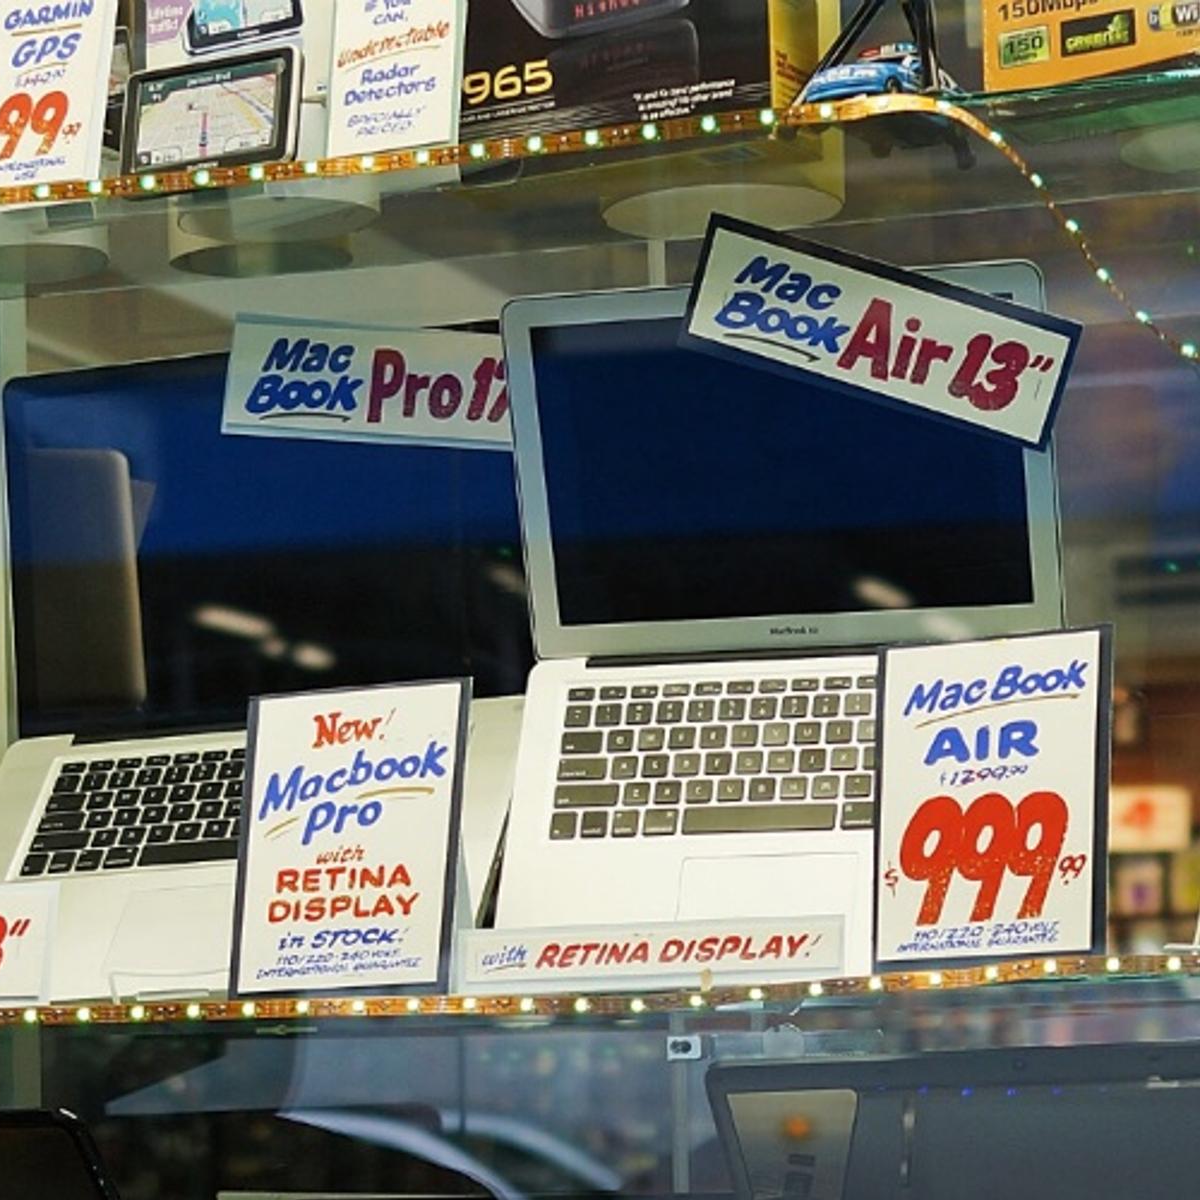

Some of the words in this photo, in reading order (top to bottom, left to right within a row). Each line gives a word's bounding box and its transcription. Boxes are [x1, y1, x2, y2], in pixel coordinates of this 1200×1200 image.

[4, 0, 95, 30] GARMIN
[11, 33, 82, 68] GPS
[1004, 34, 1044, 53] 150
[361, 63, 421, 85] Radar
[463, 59, 553, 105] 965
[344, 77, 436, 106] Detectors
[733, 255, 842, 311] Mac
[713, 291, 851, 354] Book
[262, 338, 354, 374] Mac
[923, 719, 1040, 766] AIR
[258, 740, 448, 821] Macbook
[316, 844, 366, 865] with
[275, 864, 413, 894] RETINA
[267, 892, 420, 923] DISPLAY
[481, 944, 529, 966] with
[535, 939, 650, 969] RETINA
